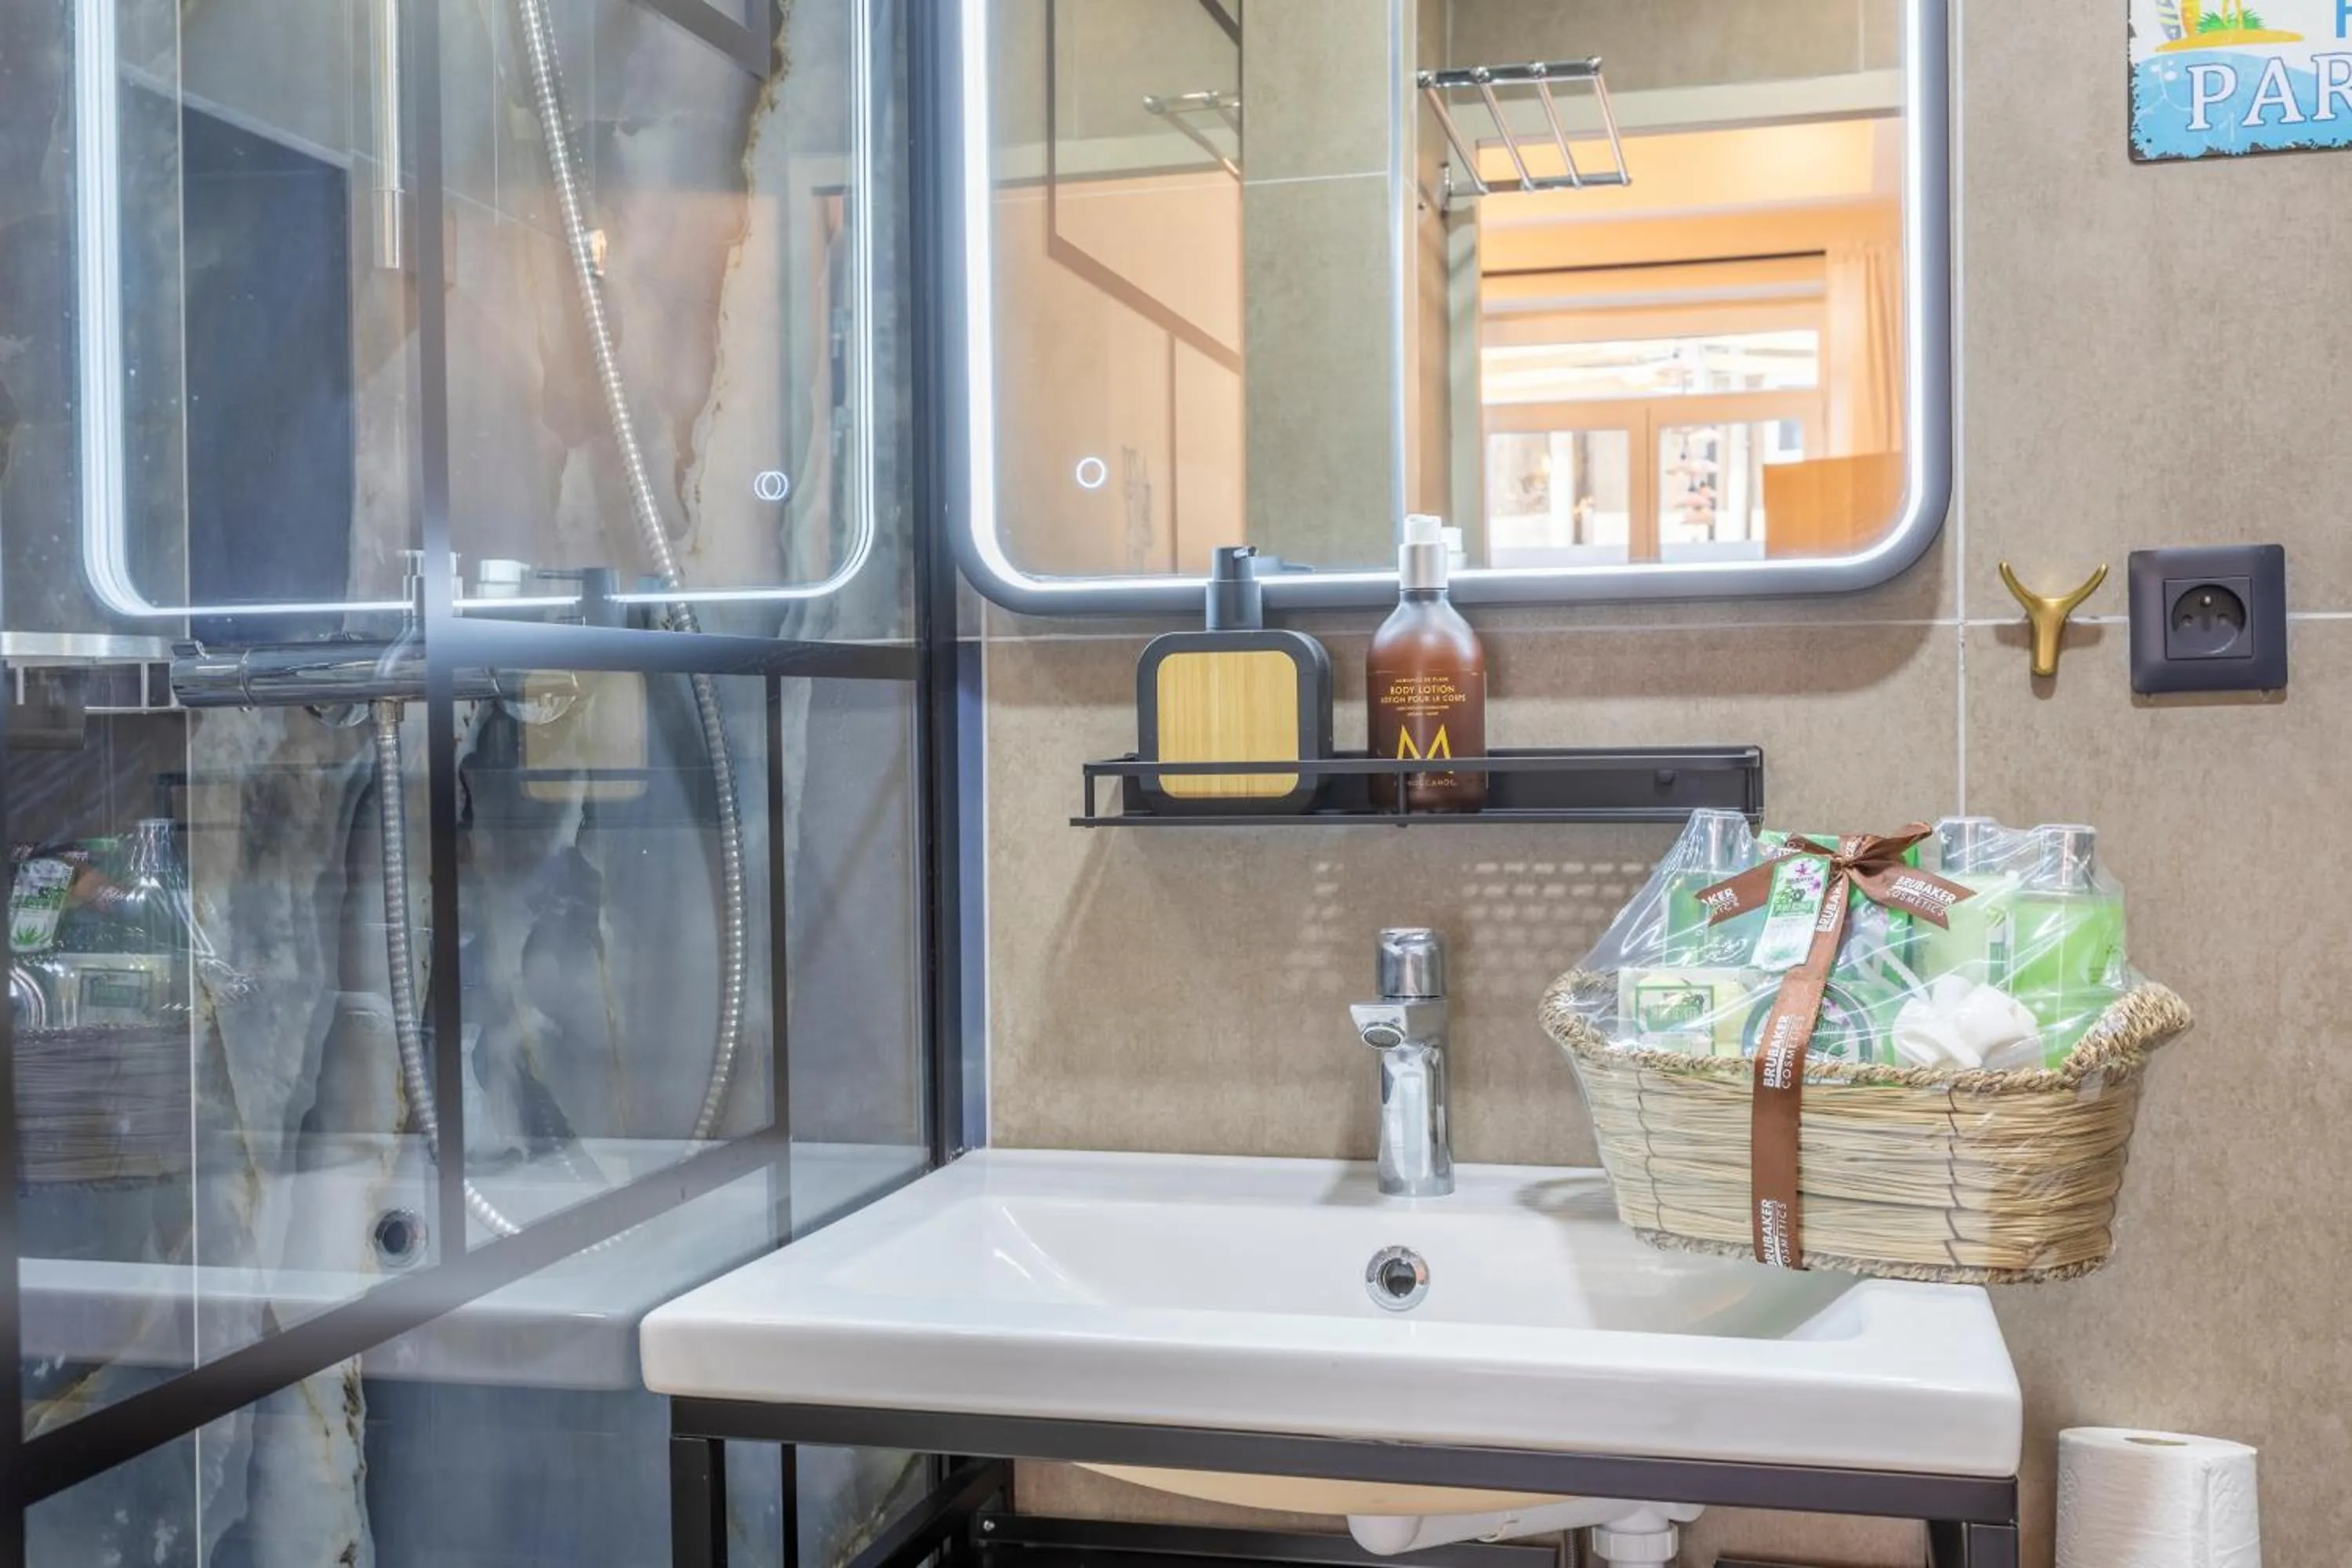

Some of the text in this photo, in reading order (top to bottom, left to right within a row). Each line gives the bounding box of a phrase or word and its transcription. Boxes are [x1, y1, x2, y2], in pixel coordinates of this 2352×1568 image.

[1390, 684, 1456, 695] BODY LOTION
[1896, 877, 1957, 904] BRUBAKER
[1762, 1015, 1788, 1087] BRUBAKER
[1777, 1203, 1791, 1265] OSMETICS
